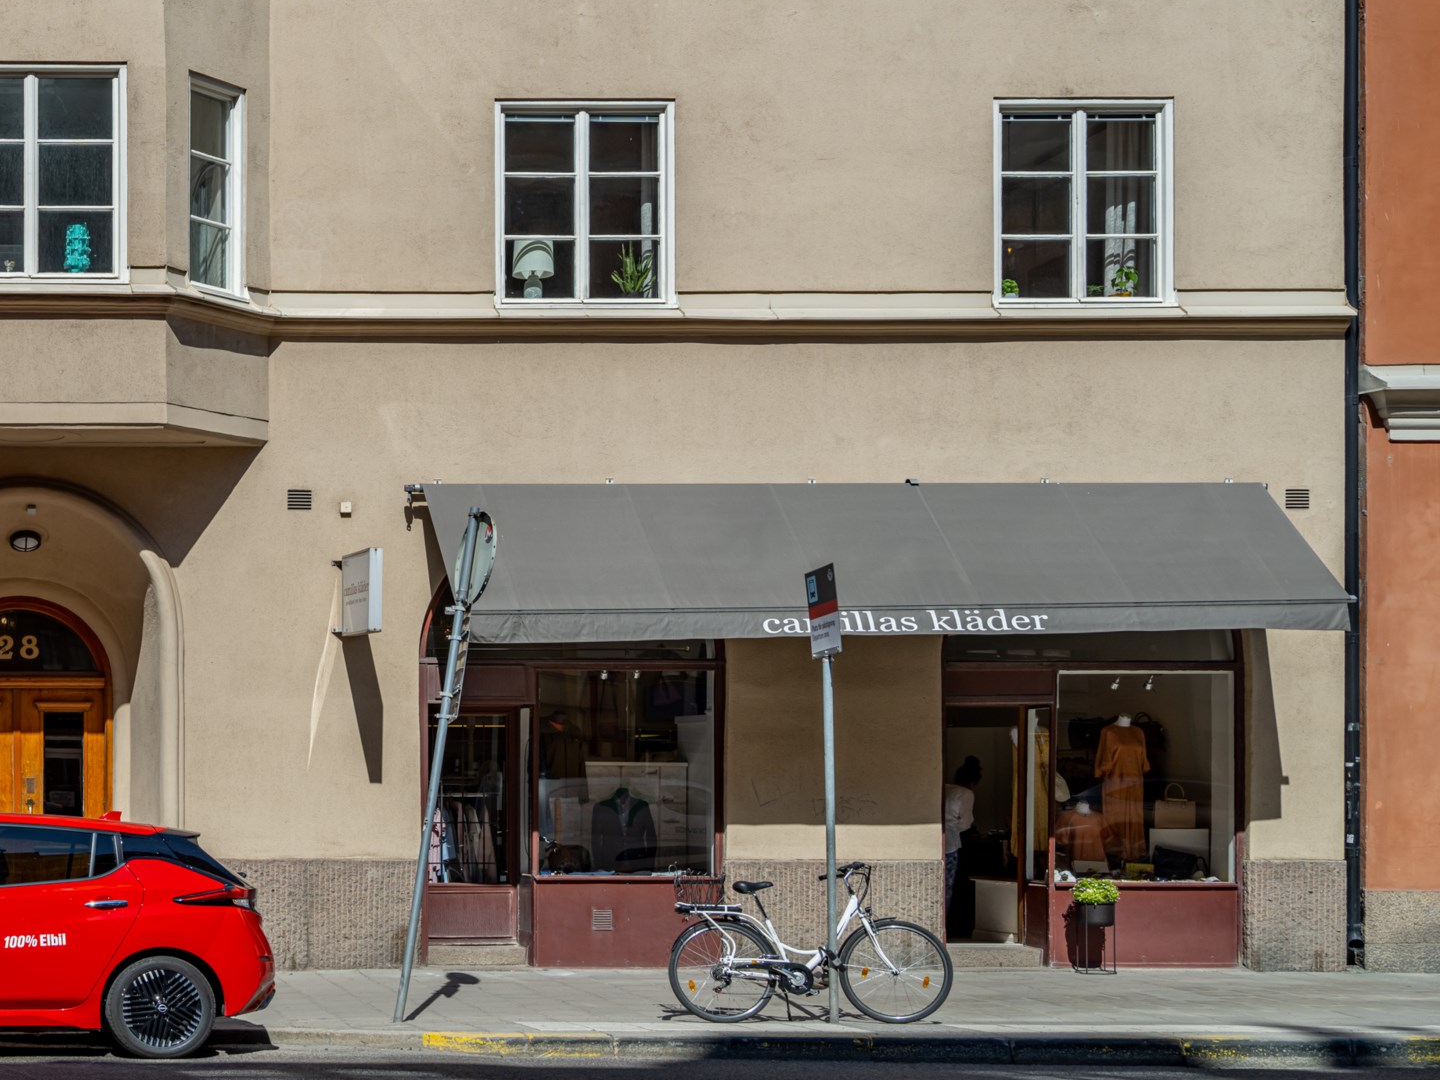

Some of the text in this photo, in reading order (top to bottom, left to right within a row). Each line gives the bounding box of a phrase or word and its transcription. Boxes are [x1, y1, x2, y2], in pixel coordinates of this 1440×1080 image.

[926, 608, 1049, 632] kläder
[3, 932, 67, 949] 100% Elbil
